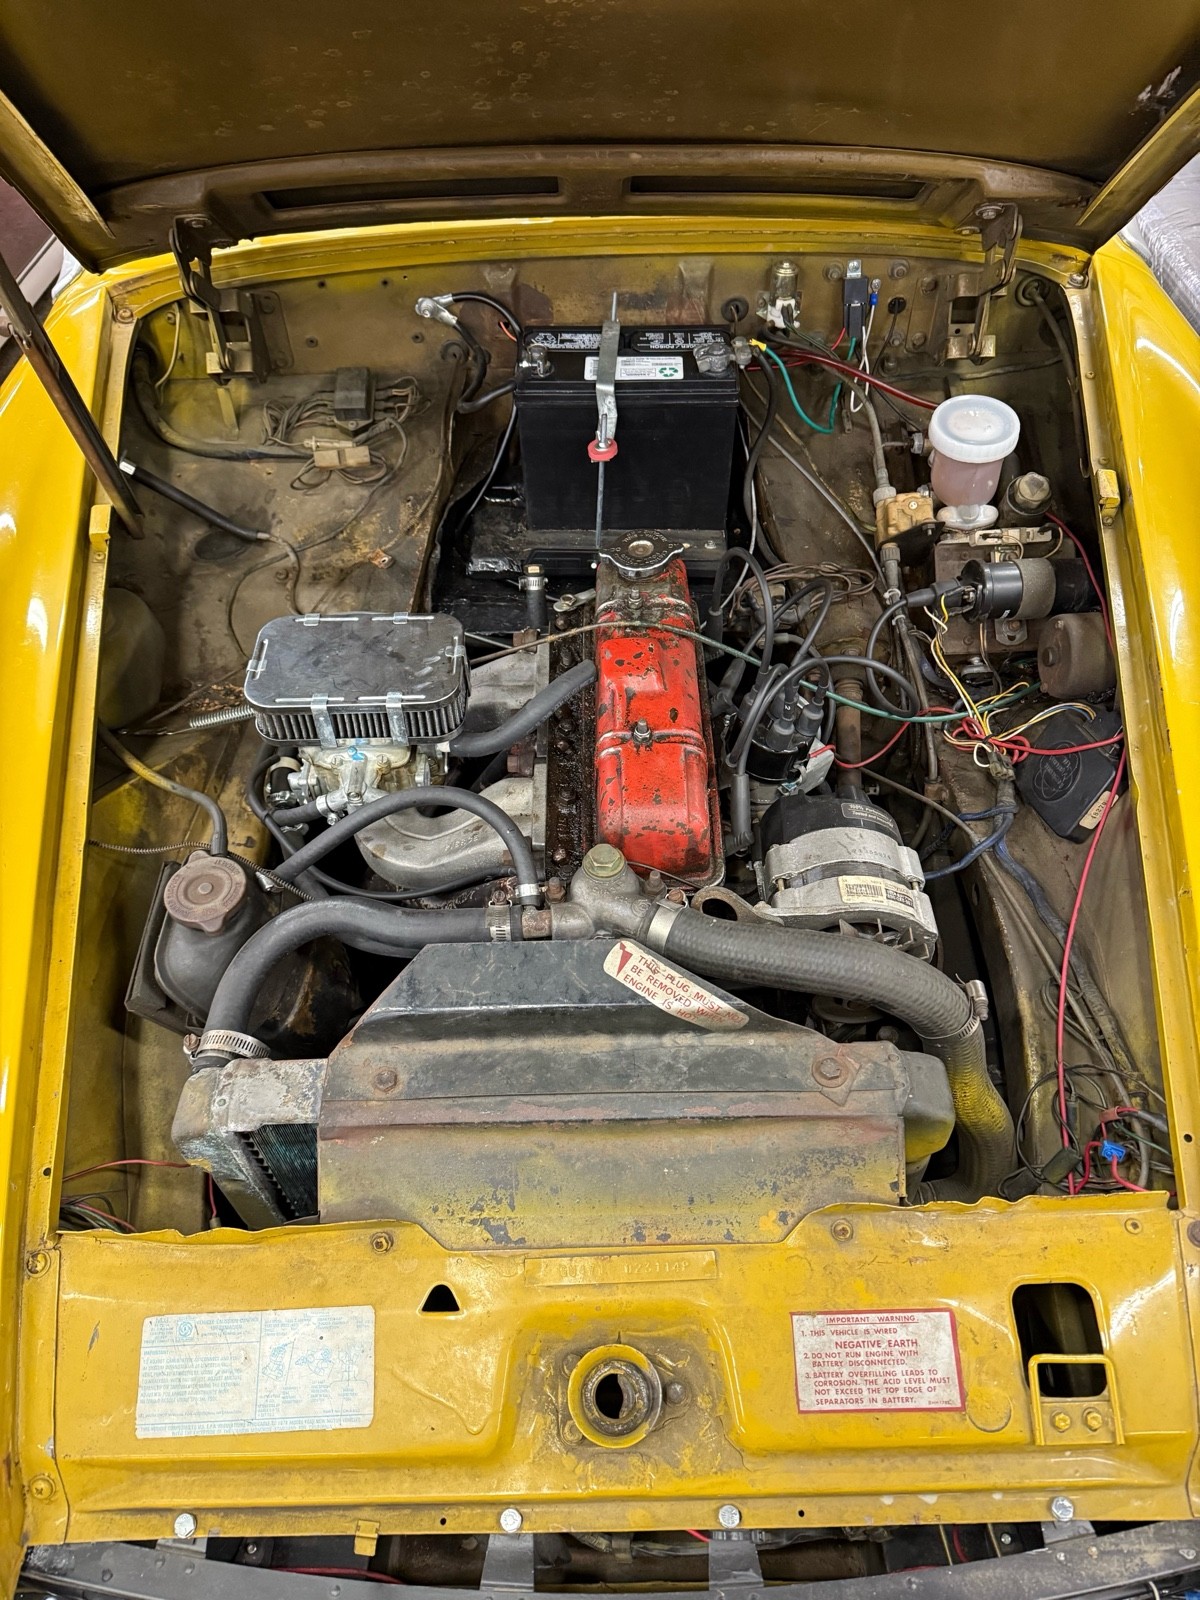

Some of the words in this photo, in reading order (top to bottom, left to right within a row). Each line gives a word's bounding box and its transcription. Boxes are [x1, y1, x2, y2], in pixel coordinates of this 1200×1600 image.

[624, 974, 658, 1000] ENGINE
[662, 998, 672, 1010] IS
[676, 1010, 697, 1022] HOT
[630, 965, 644, 976] BE
[646, 974, 692, 1008] REMOVED
[696, 1007, 724, 1023] WHEN
[665, 973, 690, 993] PLUG
[694, 992, 722, 1013] MUST
[724, 1011, 745, 1024] NOT
[835, 1340, 881, 1349] NEGATIVE
[812, 1360, 843, 1368] BATTERY
[848, 1370, 897, 1378] OVERFILLING
[816, 1397, 864, 1405] SEPARATORS
